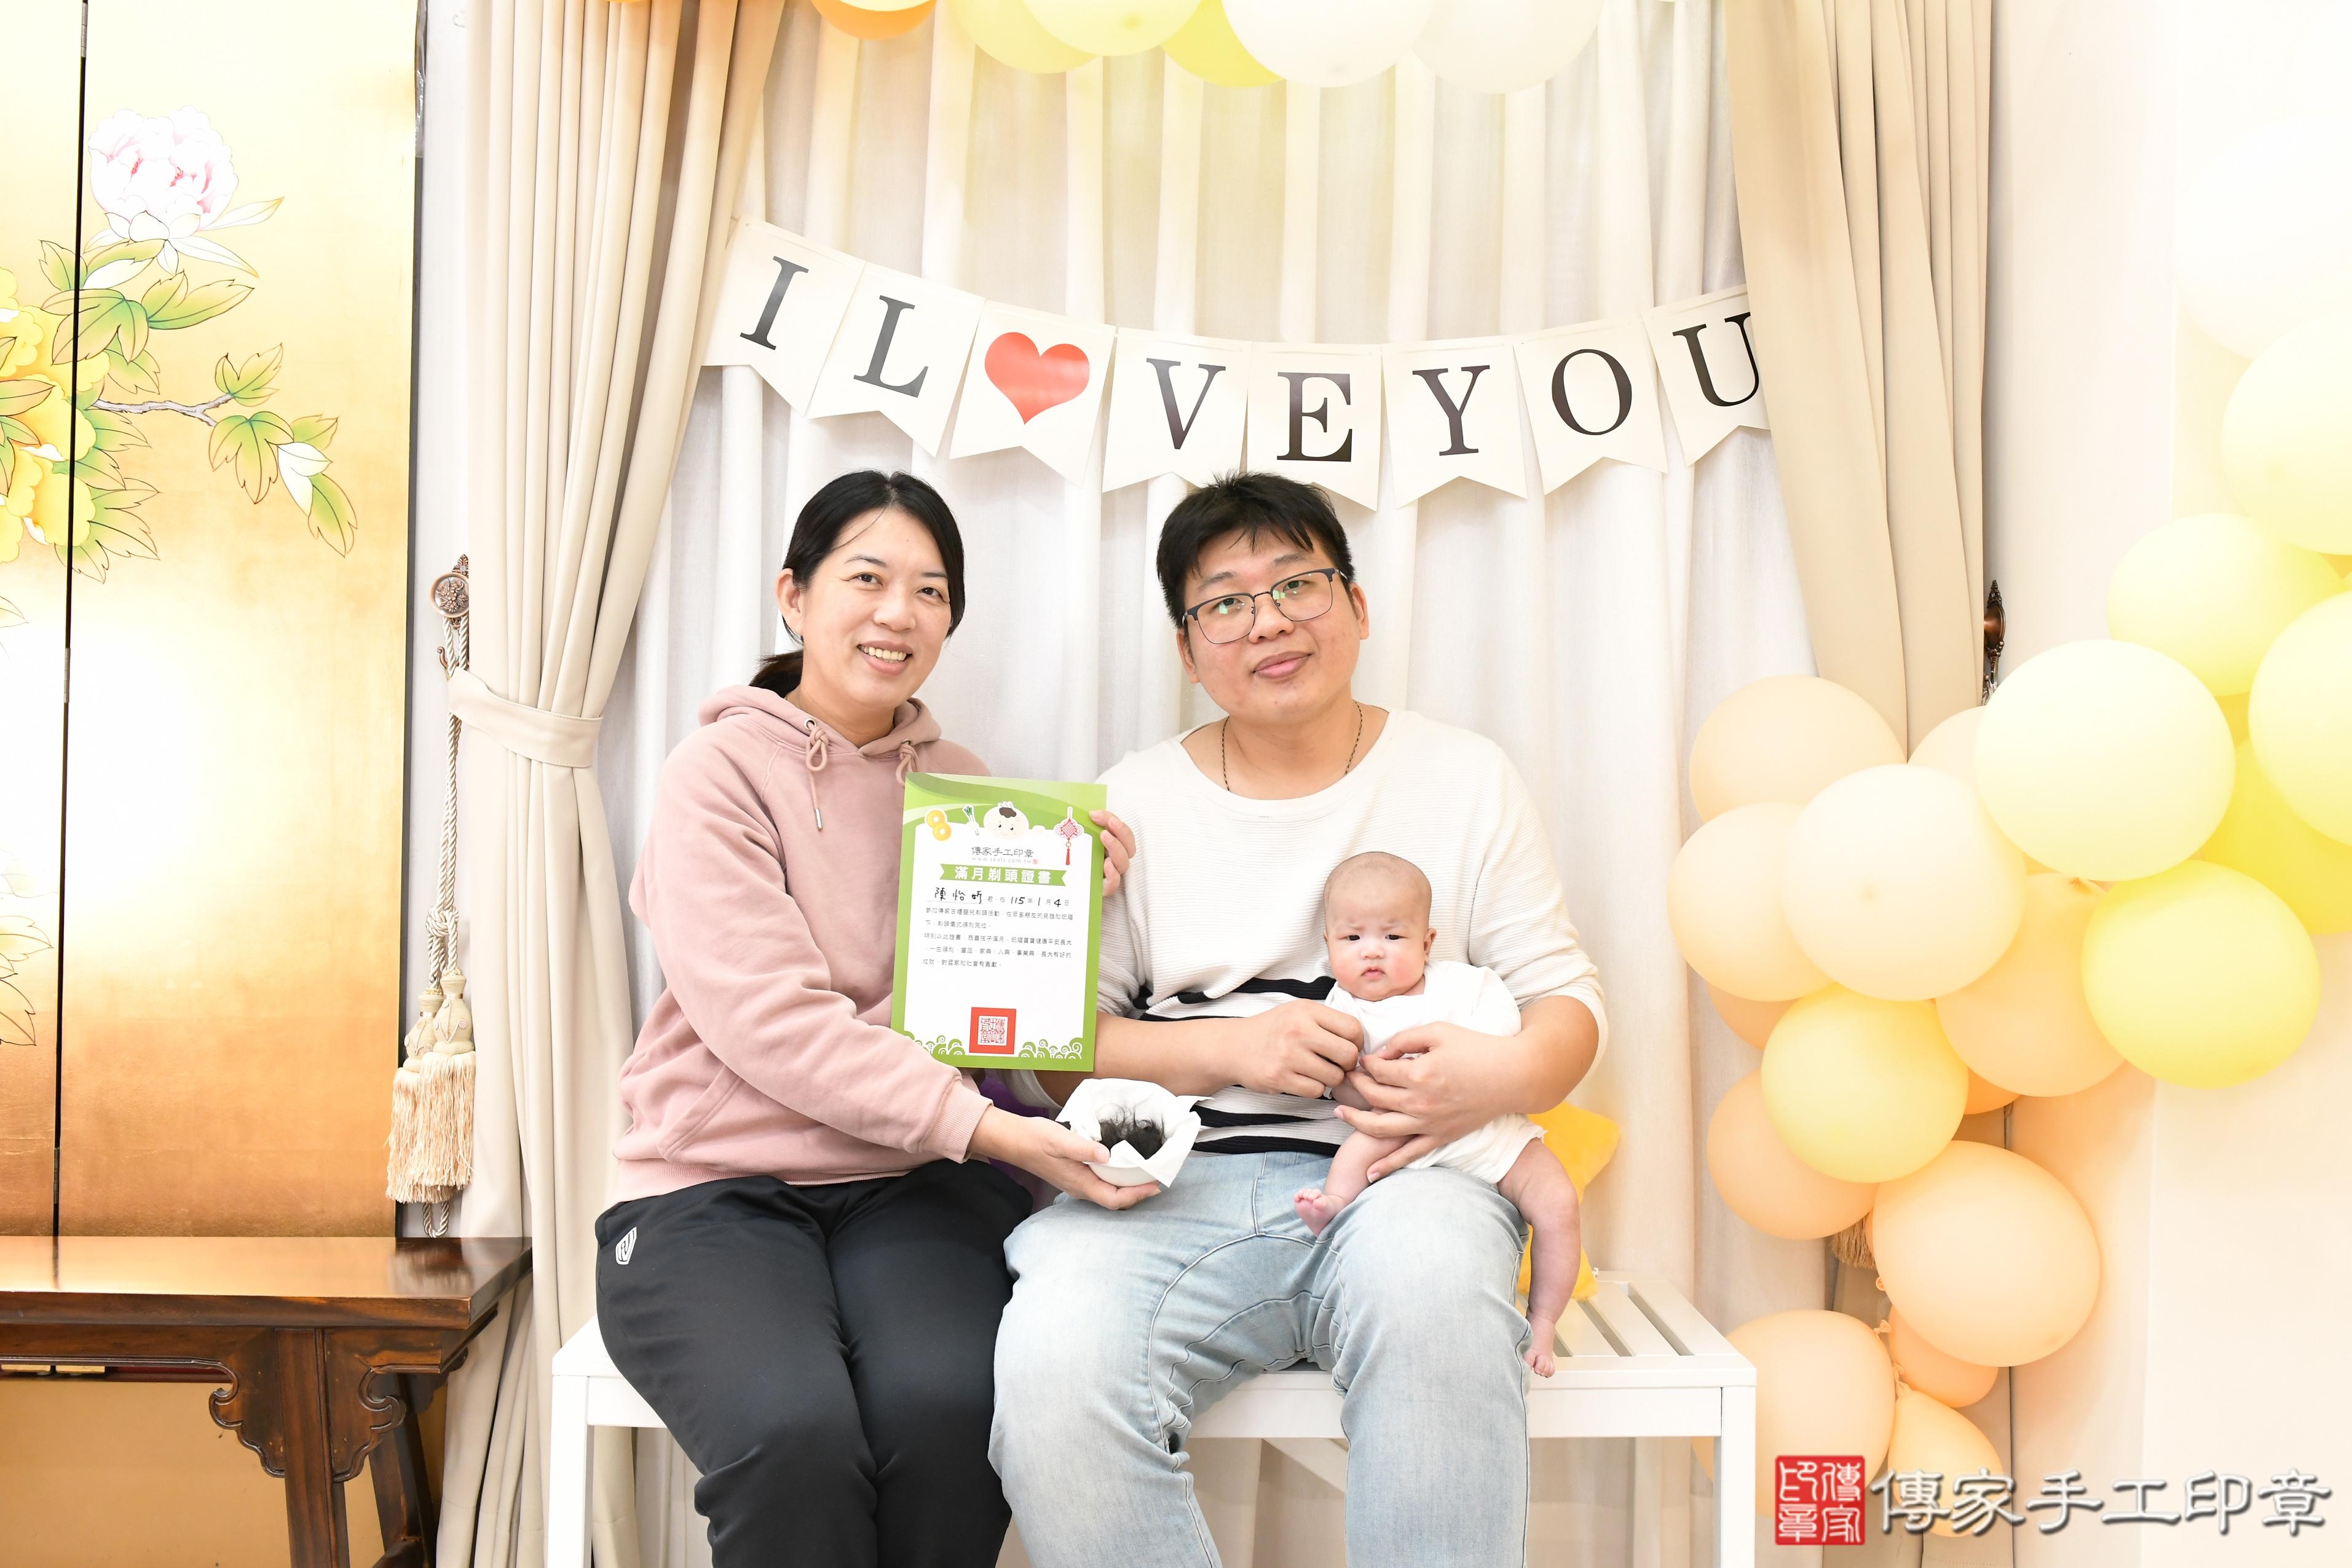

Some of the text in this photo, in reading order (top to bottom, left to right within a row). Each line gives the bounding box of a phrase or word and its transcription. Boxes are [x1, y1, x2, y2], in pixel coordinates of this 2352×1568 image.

[1412, 311, 1759, 456] YOU
[971, 846, 1034, 858] 傳家手工印章
[955, 865, 1051, 884] 滿月剃頭證書
[1011, 896, 1026, 905] 115
